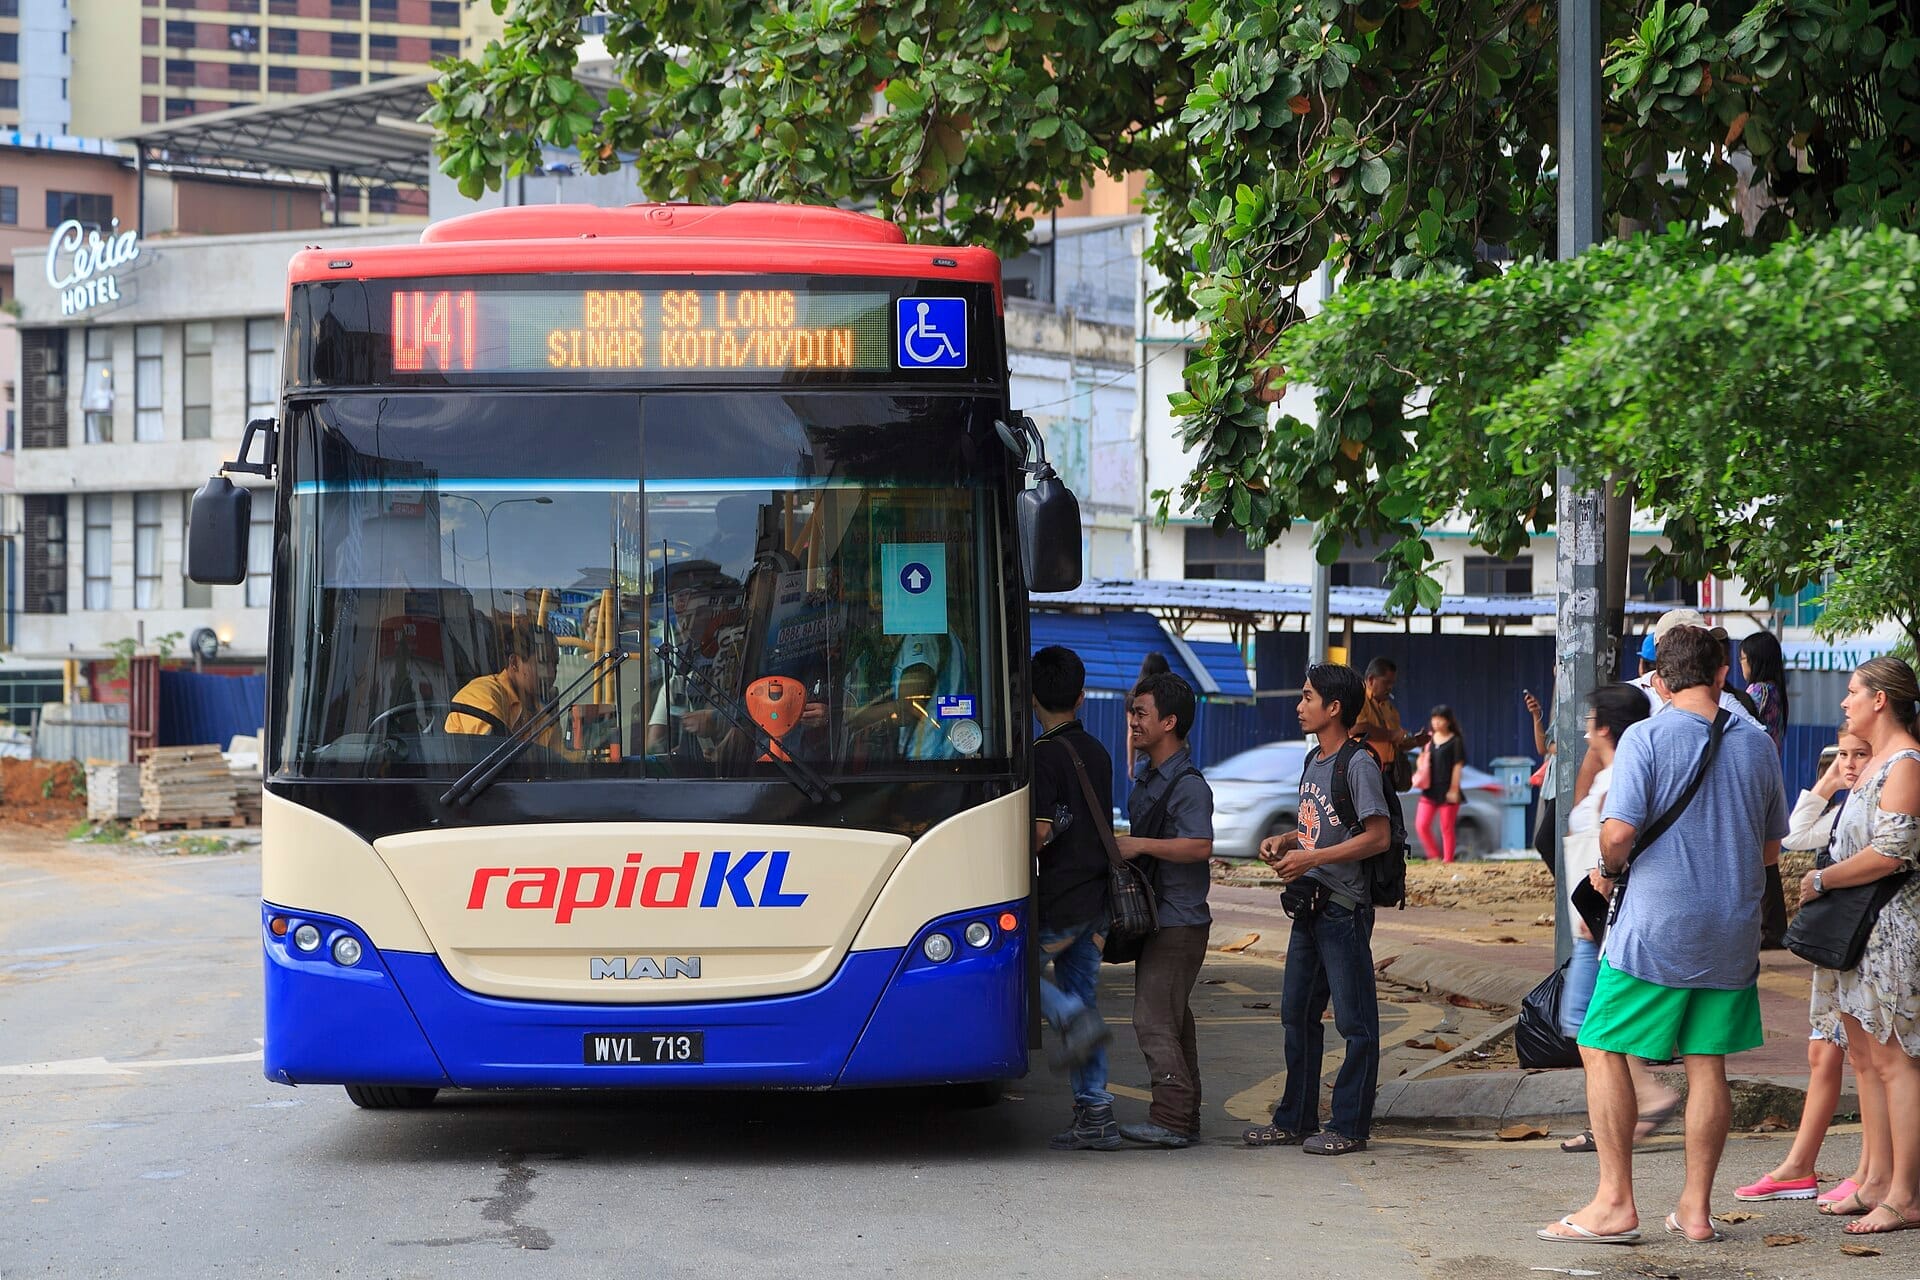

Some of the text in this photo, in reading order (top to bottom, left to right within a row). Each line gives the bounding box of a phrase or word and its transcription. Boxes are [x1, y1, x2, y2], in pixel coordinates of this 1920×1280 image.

[46, 216, 140, 290] Ceria
[61, 274, 120, 316] HOTEL
[585, 290, 796, 328] BDR SG LONG
[393, 290, 474, 370] U41
[548, 330, 852, 368] SINAR KOTA/MYDIN
[466, 851, 809, 924] rapidKL
[589, 956, 702, 980] MAN
[594, 1036, 691, 1063] WVL 713
